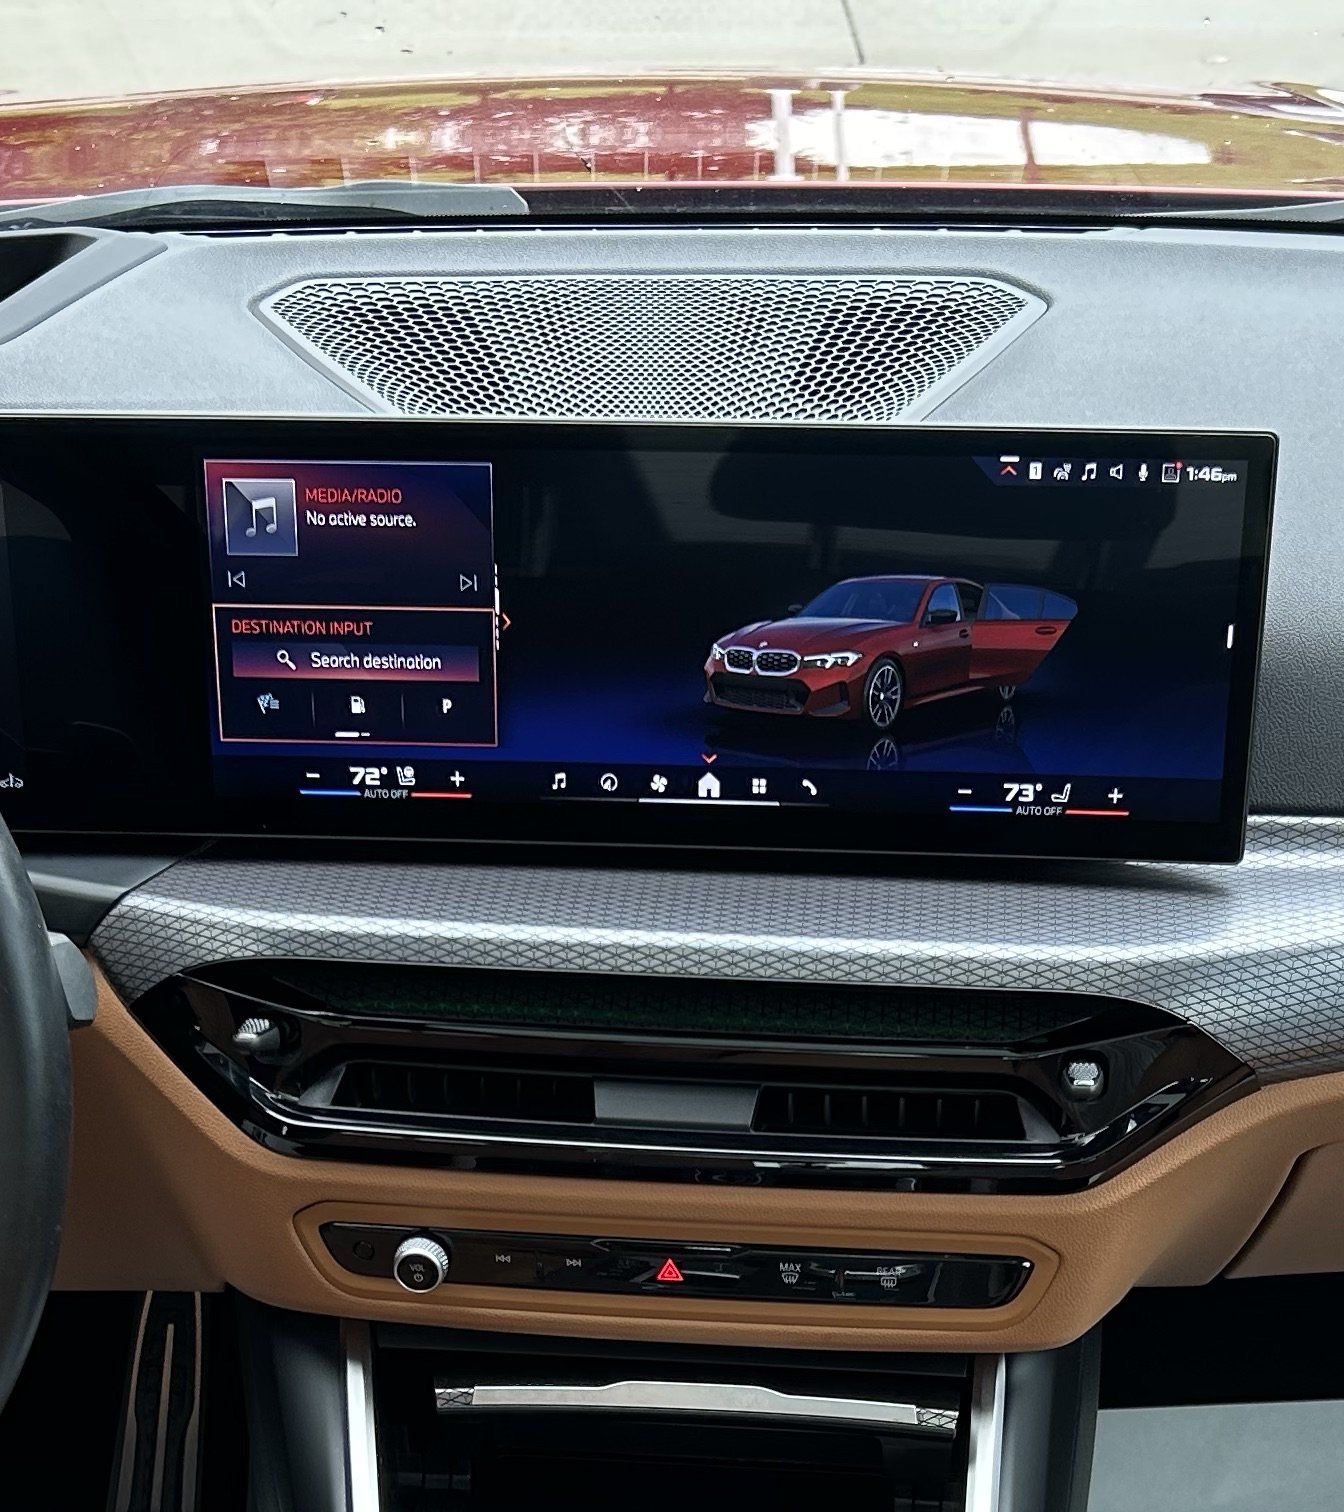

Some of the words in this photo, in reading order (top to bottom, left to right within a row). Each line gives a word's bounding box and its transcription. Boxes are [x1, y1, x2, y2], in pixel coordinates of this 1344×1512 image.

[305, 488, 402, 504] MEDIA/RADIO
[306, 510, 326, 526] No
[329, 511, 366, 527] active
[370, 513, 417, 528] source.
[232, 620, 326, 635] DESTINATION
[330, 621, 373, 636] INPUT
[311, 652, 359, 669] Search
[364, 654, 441, 670] destination
[364, 788, 389, 799] AUTO
[391, 789, 408, 799] OFF
[1016, 806, 1041, 816] AUTO
[1044, 806, 1063, 816] OFF
[780, 1262, 801, 1273] MAX
